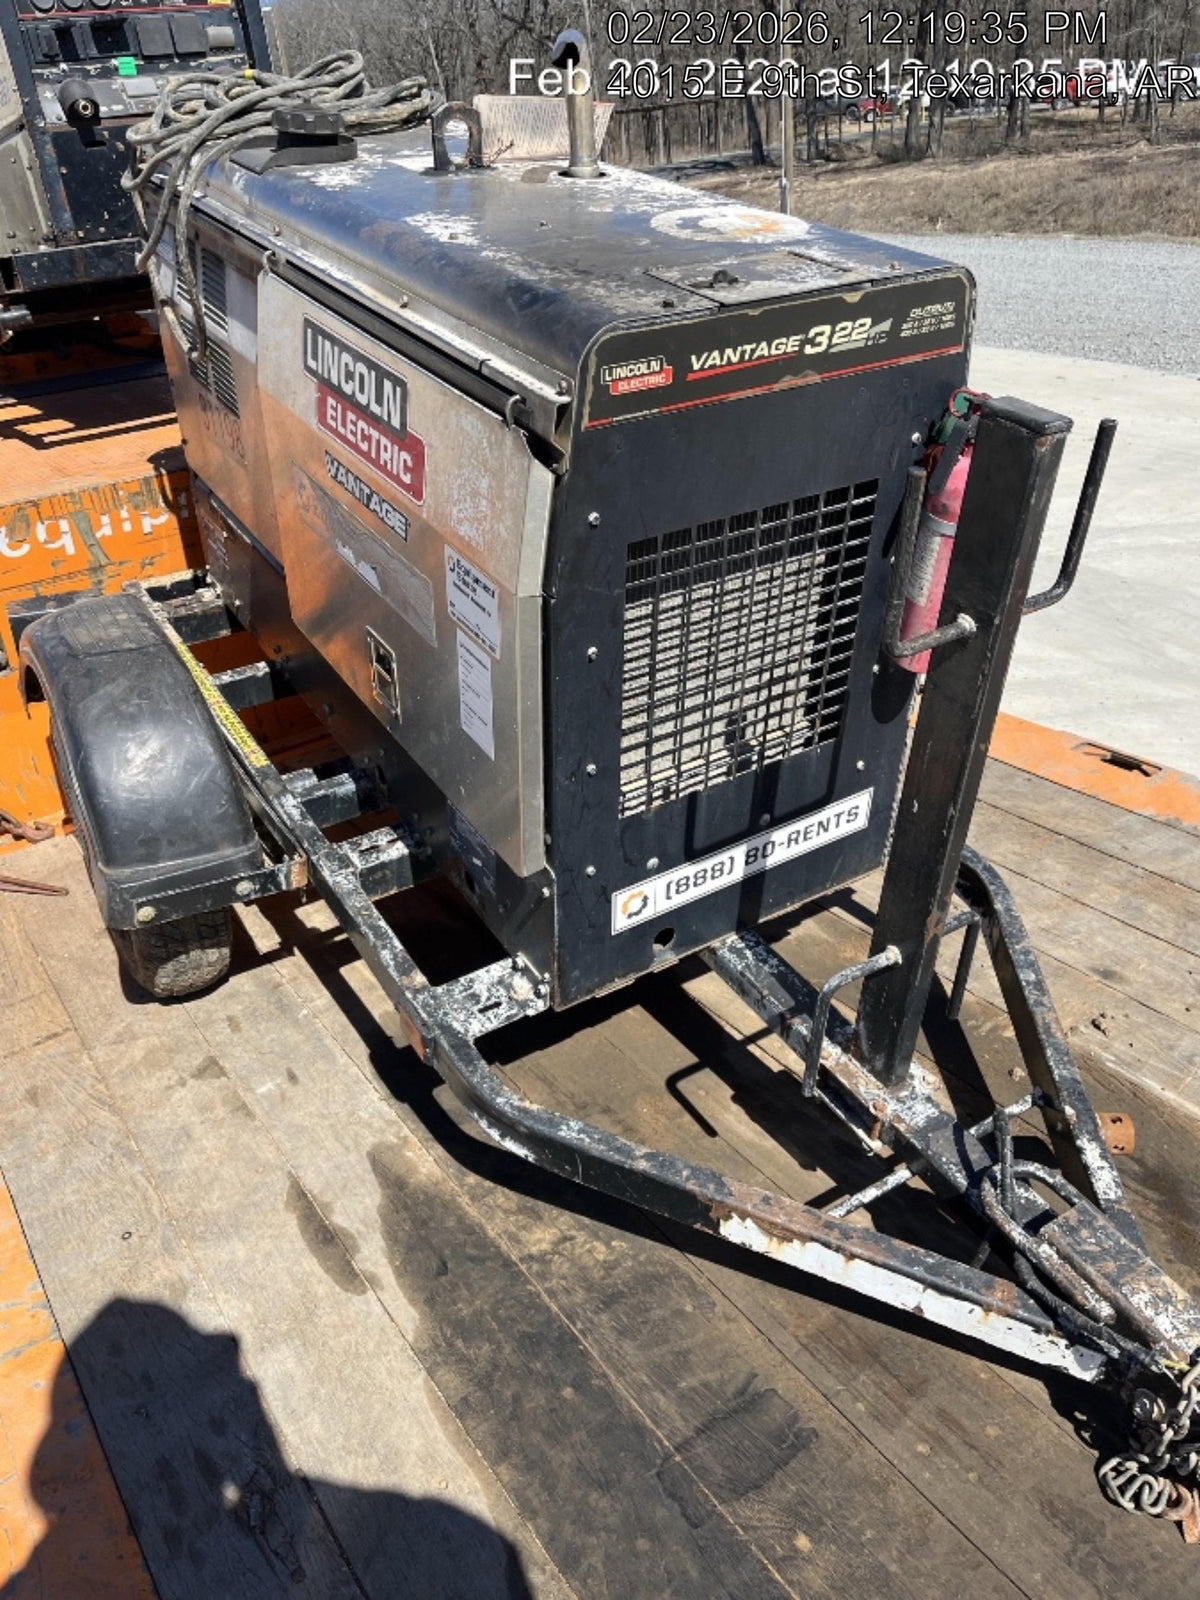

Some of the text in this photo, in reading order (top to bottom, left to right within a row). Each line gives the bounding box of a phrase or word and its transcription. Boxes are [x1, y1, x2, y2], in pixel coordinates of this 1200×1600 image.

[604, 359, 661, 382] LINCOLN
[690, 334, 803, 370] VANTAGE
[804, 317, 872, 354] 322
[306, 328, 402, 431] LINCOLN
[618, 373, 666, 392] ELECTRIC
[326, 396, 413, 485] ELECTRIC
[326, 452, 408, 540] VANTAGE
